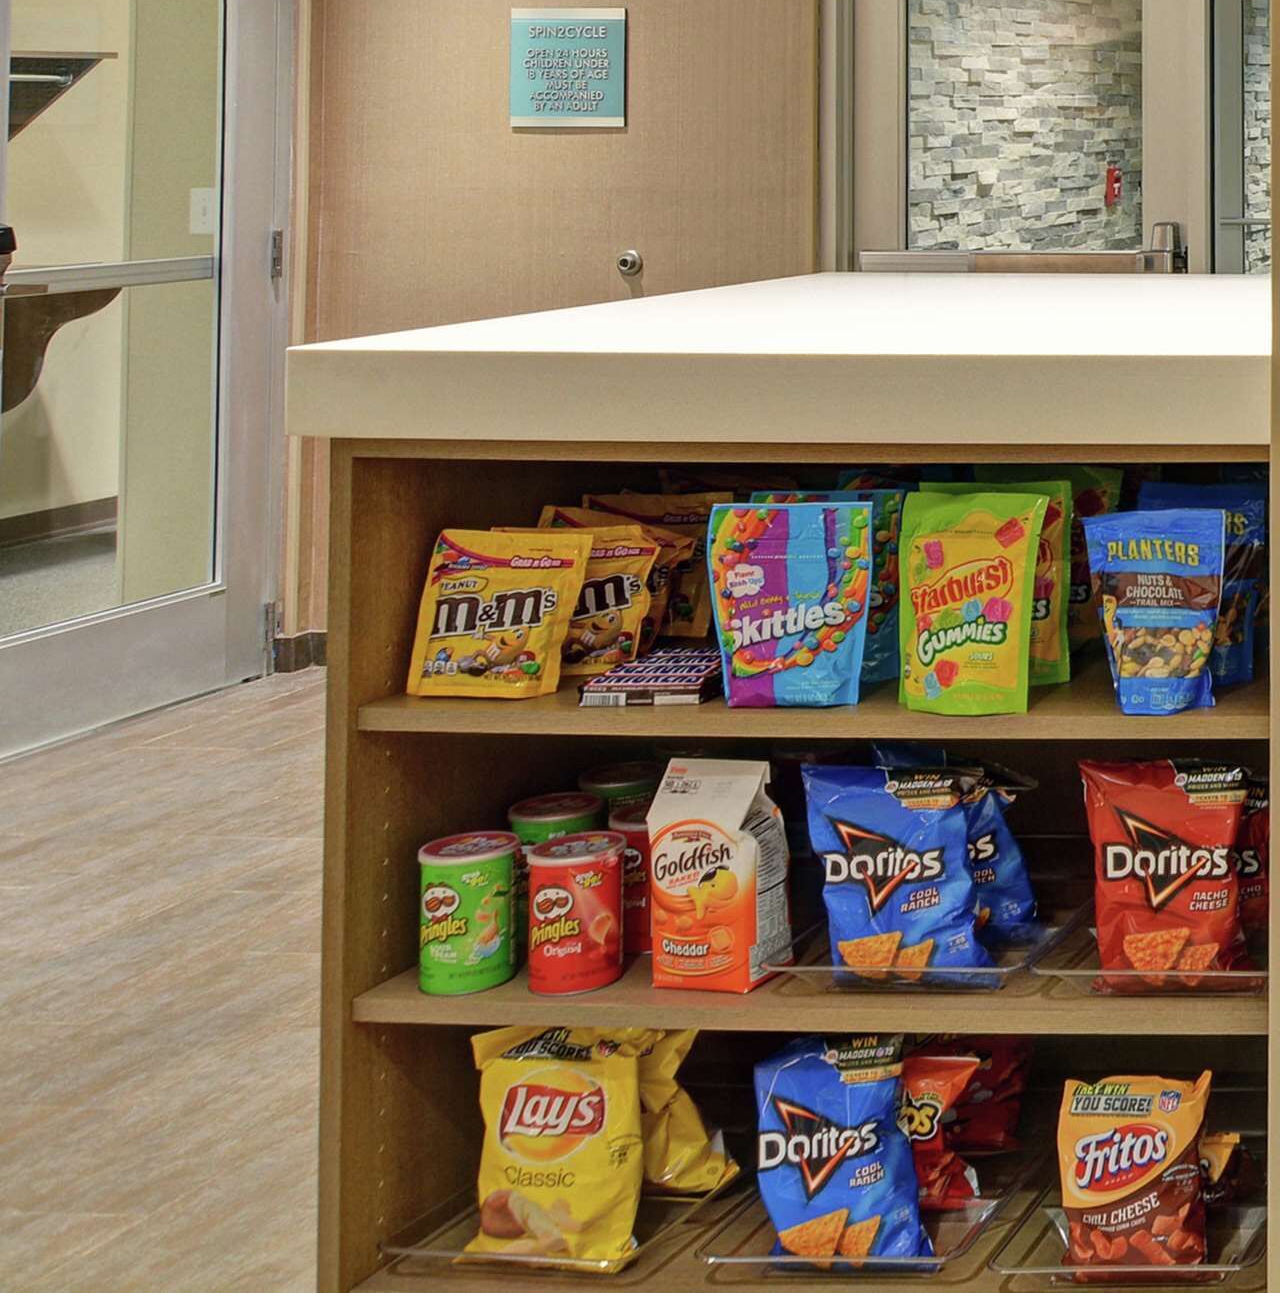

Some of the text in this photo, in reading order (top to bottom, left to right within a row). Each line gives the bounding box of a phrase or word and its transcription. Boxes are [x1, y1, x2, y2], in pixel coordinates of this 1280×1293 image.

[528, 26, 608, 39] SPIN2CYCLE
[527, 48, 608, 59] OPEN 24 HOURS
[523, 59, 610, 69] CHILDREN UNDER
[539, 69, 568, 80] YEARS
[570, 69, 585, 80] OF
[587, 69, 609, 80] AGE
[546, 81, 588, 90] MUST BE
[530, 91, 604, 101] ACCOMPANIED
[534, 101, 599, 112] BY AN ADULT
[1107, 538, 1200, 566] PLANTERS
[912, 559, 1010, 615] Starburst
[1137, 574, 1173, 587] NUTS &
[1126, 586, 1184, 600] CHOCOLATE
[730, 601, 847, 652] Skittles
[1188, 773, 1225, 783] MADDEN
[654, 842, 732, 882] Goldfish
[825, 847, 942, 883] Doritos
[1107, 845, 1229, 879] Doritos
[909, 887, 938, 901] COOL
[1193, 889, 1228, 901] NACHO
[901, 897, 941, 913] RANCH
[1189, 897, 1229, 911] CHEESE
[420, 916, 467, 947] Pringles
[531, 917, 581, 949] Pringles
[543, 941, 582, 958] Original
[662, 937, 710, 957] Cheddar
[852, 1035, 878, 1047] WIN
[839, 1049, 875, 1060] MADDEN
[1104, 1083, 1130, 1095] WIN
[503, 1086, 602, 1138] Lay's
[1073, 1095, 1151, 1113] YOU SCORE!
[758, 1122, 879, 1169] Doritos
[1074, 1127, 1169, 1189] Fritos
[503, 1165, 577, 1188] Classic
[855, 1162, 882, 1176] COOL
[849, 1171, 886, 1188] RANCH
[1082, 1191, 1161, 1225] CHILI CHEESE
